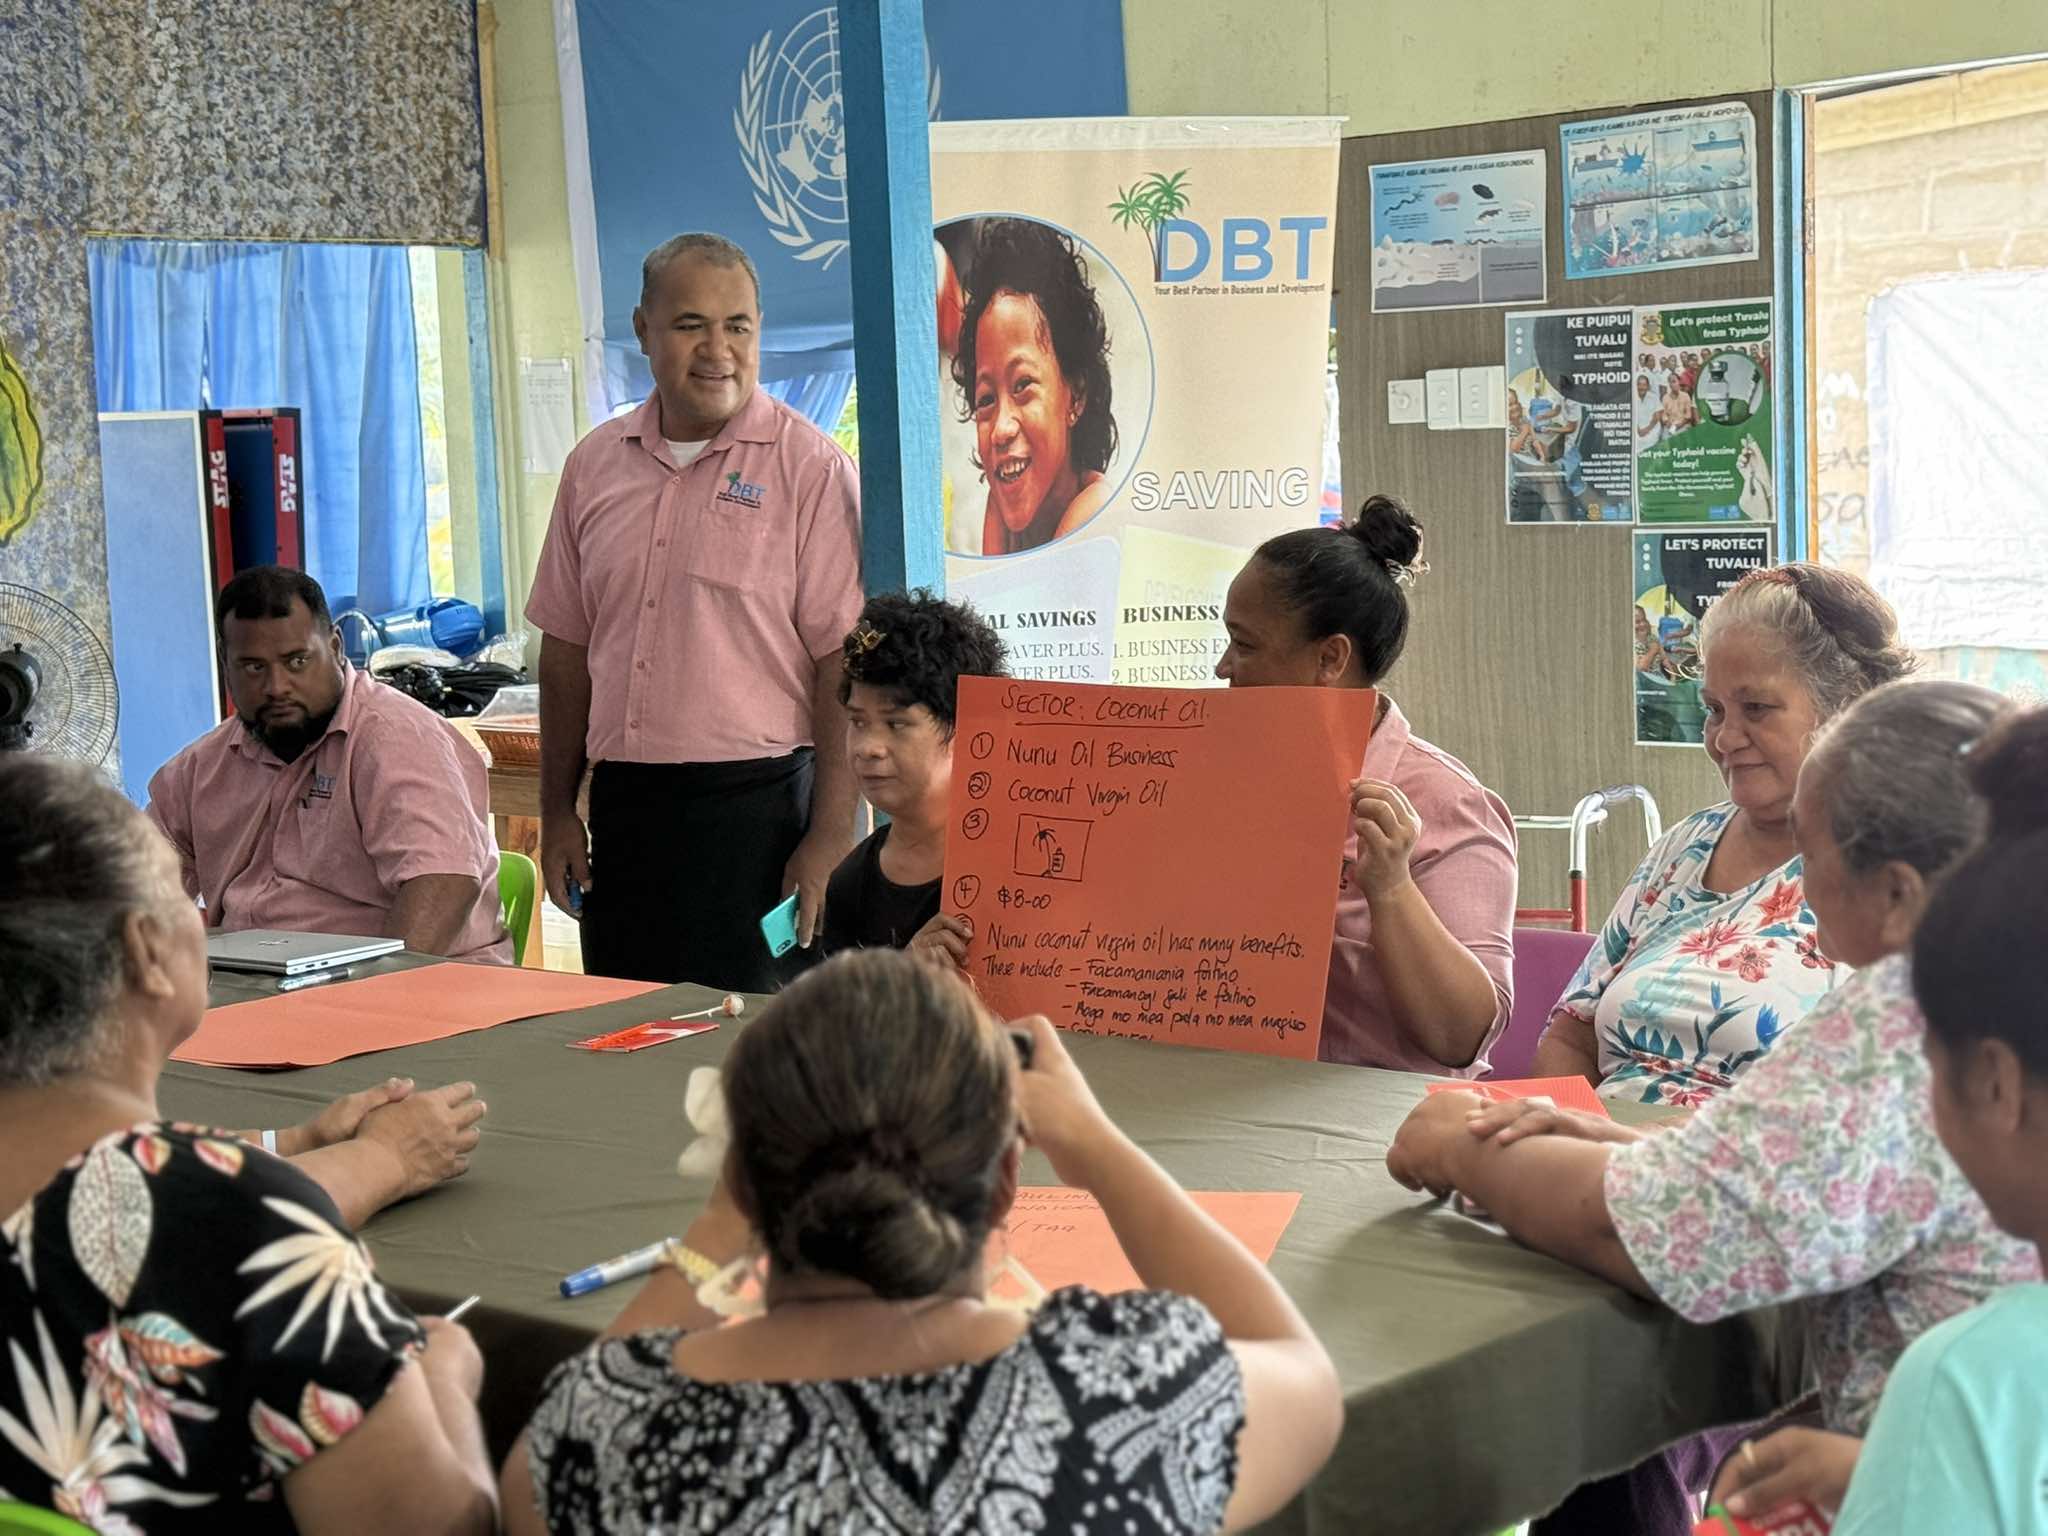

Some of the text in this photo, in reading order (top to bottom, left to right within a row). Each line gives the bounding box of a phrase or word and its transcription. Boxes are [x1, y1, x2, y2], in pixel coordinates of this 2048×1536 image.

[1161, 216, 1328, 282] DBT
[1154, 283, 1326, 295] Your Best Partner in Business and Development
[1566, 314, 1630, 328] KE PUIPUI
[1670, 311, 1769, 327] Let's protect Tuvalu
[1574, 333, 1627, 347] TUVALU
[1728, 325, 1769, 337] Typhoid
[1572, 371, 1631, 384] TYPHOID
[1672, 446, 1705, 458] Typhoid
[279, 453, 297, 513] STAG
[1131, 467, 1310, 512] SAVING
[1665, 538, 1765, 551] LET'S PROTECT
[1705, 557, 1761, 569] TUVALU
[1717, 581, 1739, 589] FRO
[987, 609, 1097, 630] AL SAVINGS
[1122, 604, 1220, 624] BUSINESS
[1009, 641, 1105, 659] AVER PLUS.
[1113, 643, 1124, 659] 1.
[1128, 639, 1209, 658] BUSINESS
[1048, 664, 1095, 680] PLUS.
[1111, 668, 1124, 685] 2.
[1128, 664, 1208, 684] BUSINESS
[1001, 684, 1085, 720] SECTOR:
[1096, 696, 1168, 722] Coconut
[1007, 737, 1057, 767] Nunu
[1071, 739, 1095, 768] Oil
[1107, 741, 1179, 768] Business
[1008, 777, 1075, 803] Coconut
[1086, 782, 1130, 817] Virgin
[1139, 778, 1168, 807] Oil
[987, 921, 1027, 951] Nunu
[1034, 921, 1092, 950] coconut
[1096, 933, 1136, 961] virgin
[1142, 924, 1164, 955] oil
[1169, 932, 1195, 953] has
[1199, 937, 1235, 964] many
[982, 954, 1015, 978] These
[1019, 957, 1064, 978] include
[1196, 985, 1208, 1004] te
[1112, 1010, 1132, 1023] mo
[1138, 1009, 1164, 1025] mea
